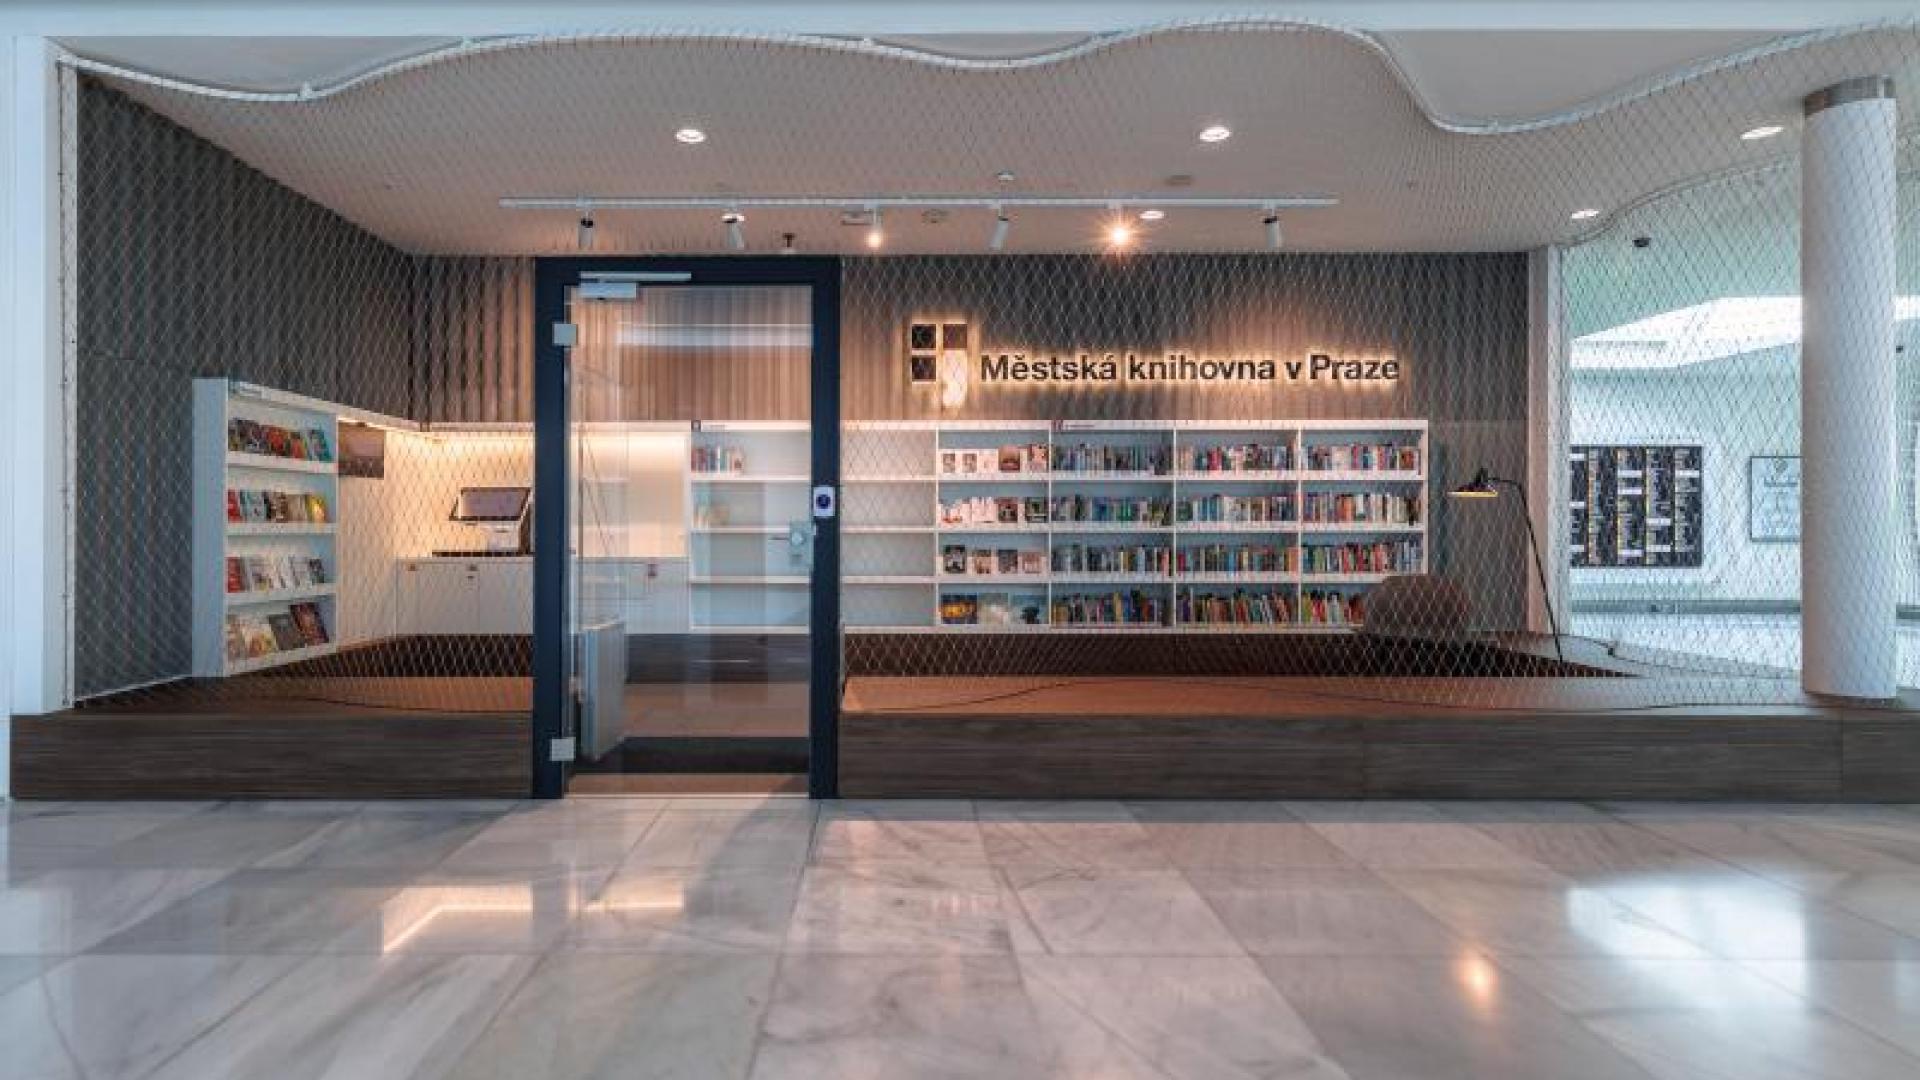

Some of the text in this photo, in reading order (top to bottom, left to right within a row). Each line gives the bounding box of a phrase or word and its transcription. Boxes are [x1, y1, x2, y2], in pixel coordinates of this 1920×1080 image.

[981, 354, 1400, 381] Městská knihovna v Praze
